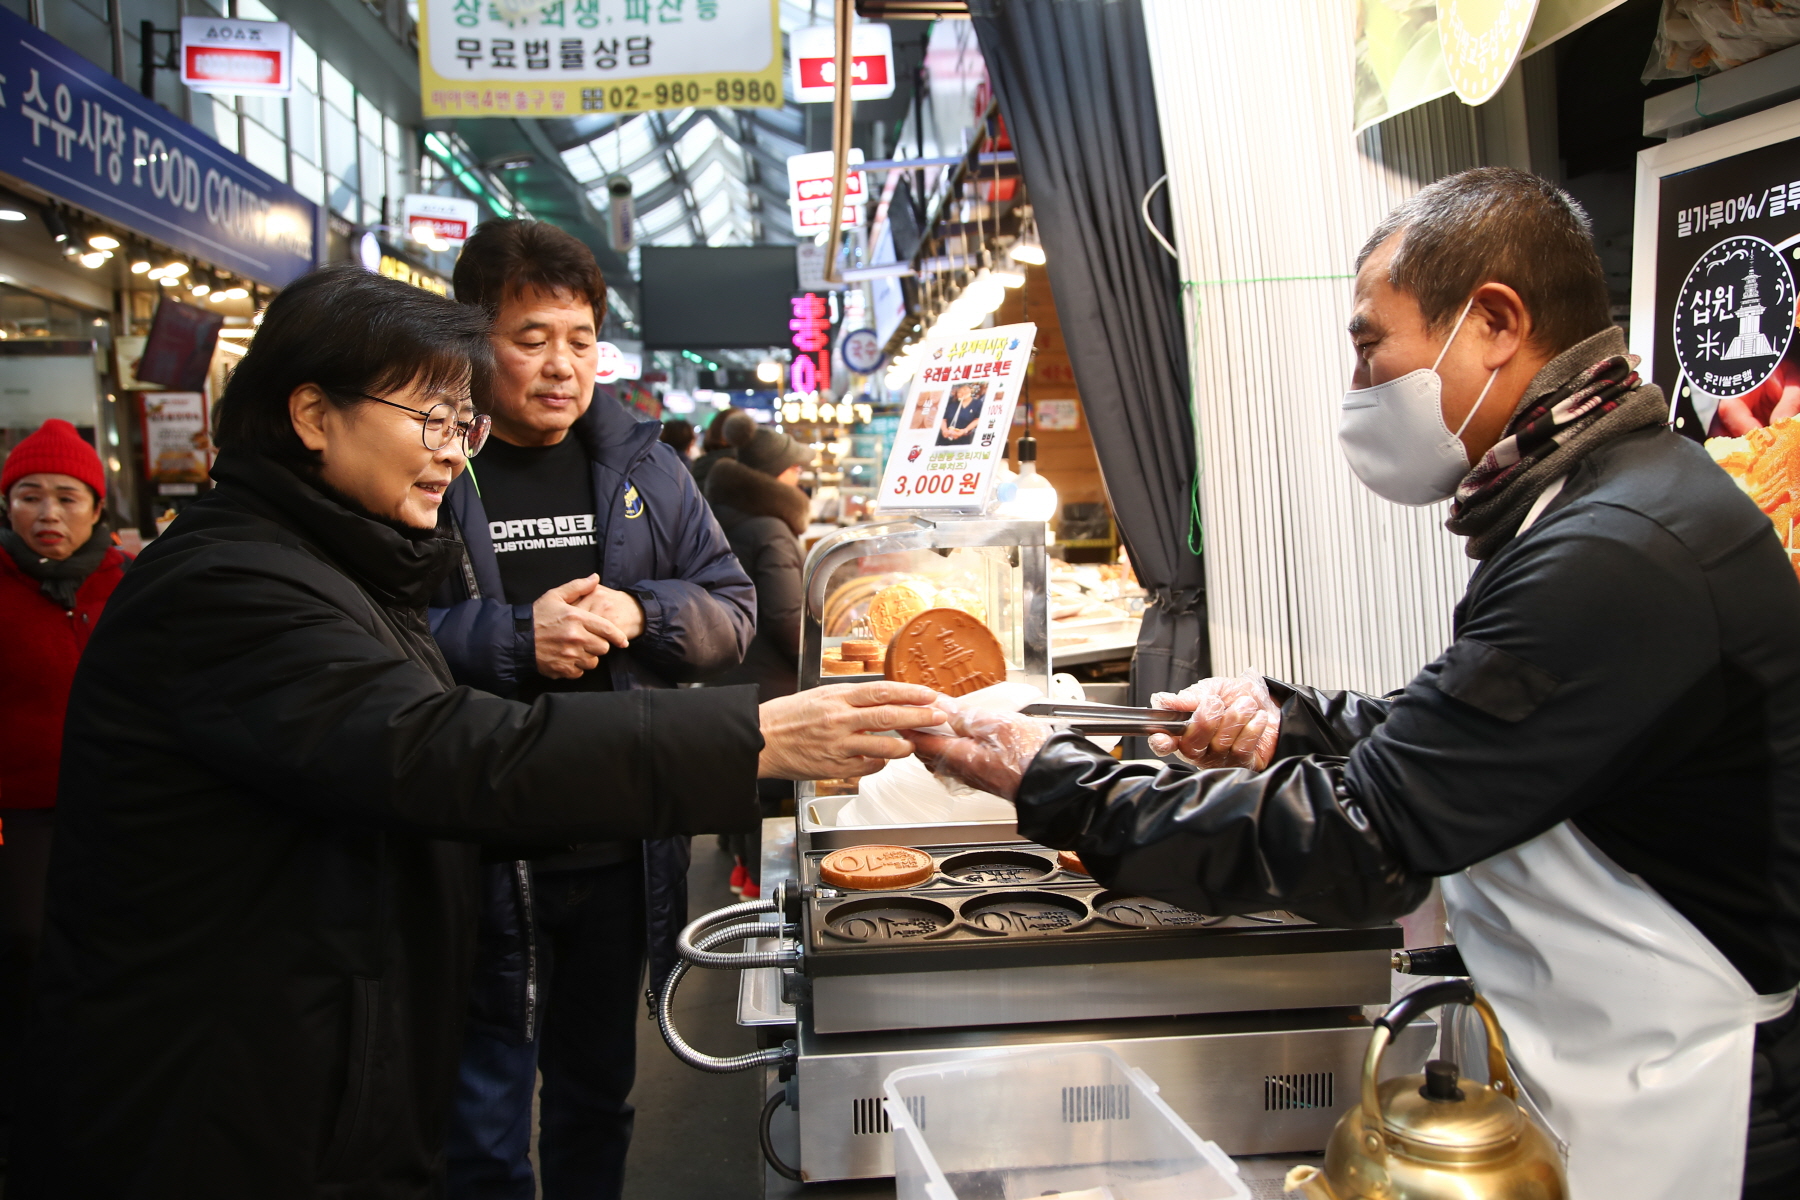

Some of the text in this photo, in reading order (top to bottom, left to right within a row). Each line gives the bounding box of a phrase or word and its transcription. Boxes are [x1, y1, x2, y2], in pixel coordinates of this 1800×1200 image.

[625, 0, 682, 25] 파산
[456, 35, 653, 71] 무료법률상담
[609, 79, 777, 109] 02-980-8980
[21, 68, 126, 185] 수유시장
[133, 127, 200, 213] FOOD
[1689, 284, 1735, 327] 십원
[789, 292, 832, 394] 홍어
[1703, 368, 1753, 388] 우리쌀은행
[987, 404, 1003, 416] 100%
[981, 431, 996, 448] 빵
[894, 472, 981, 497] 3,000 원
[546, 535, 588, 549] DENIM
